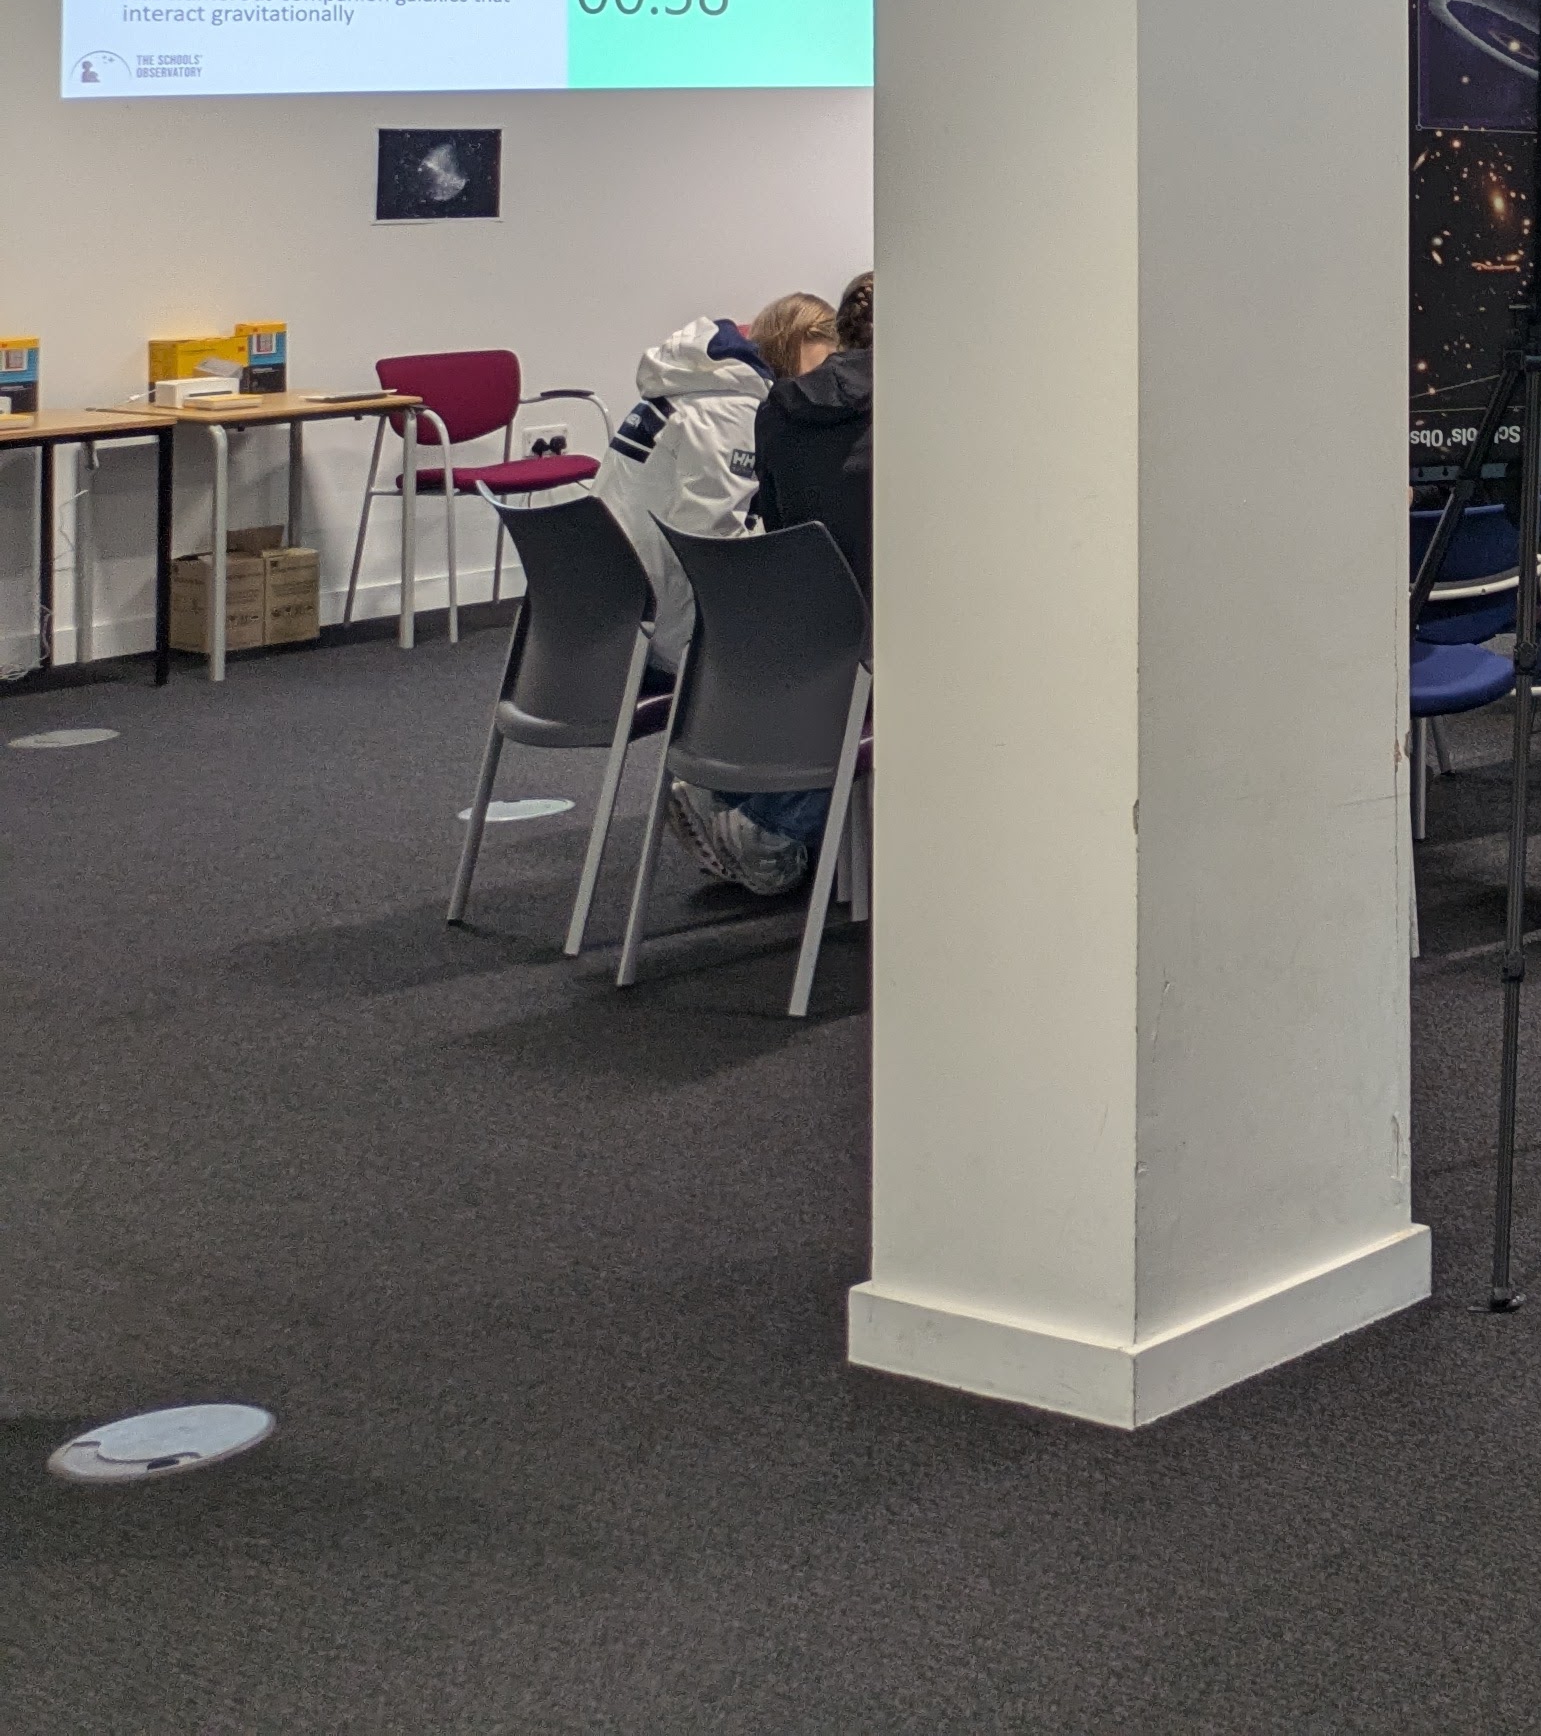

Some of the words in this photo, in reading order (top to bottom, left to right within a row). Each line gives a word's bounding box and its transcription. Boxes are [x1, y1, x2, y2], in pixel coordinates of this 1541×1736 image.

[123, 6, 205, 22] interact
[212, 6, 354, 25] gravitationally
[137, 55, 154, 65] THE
[137, 67, 202, 78] OBSERVATORY
